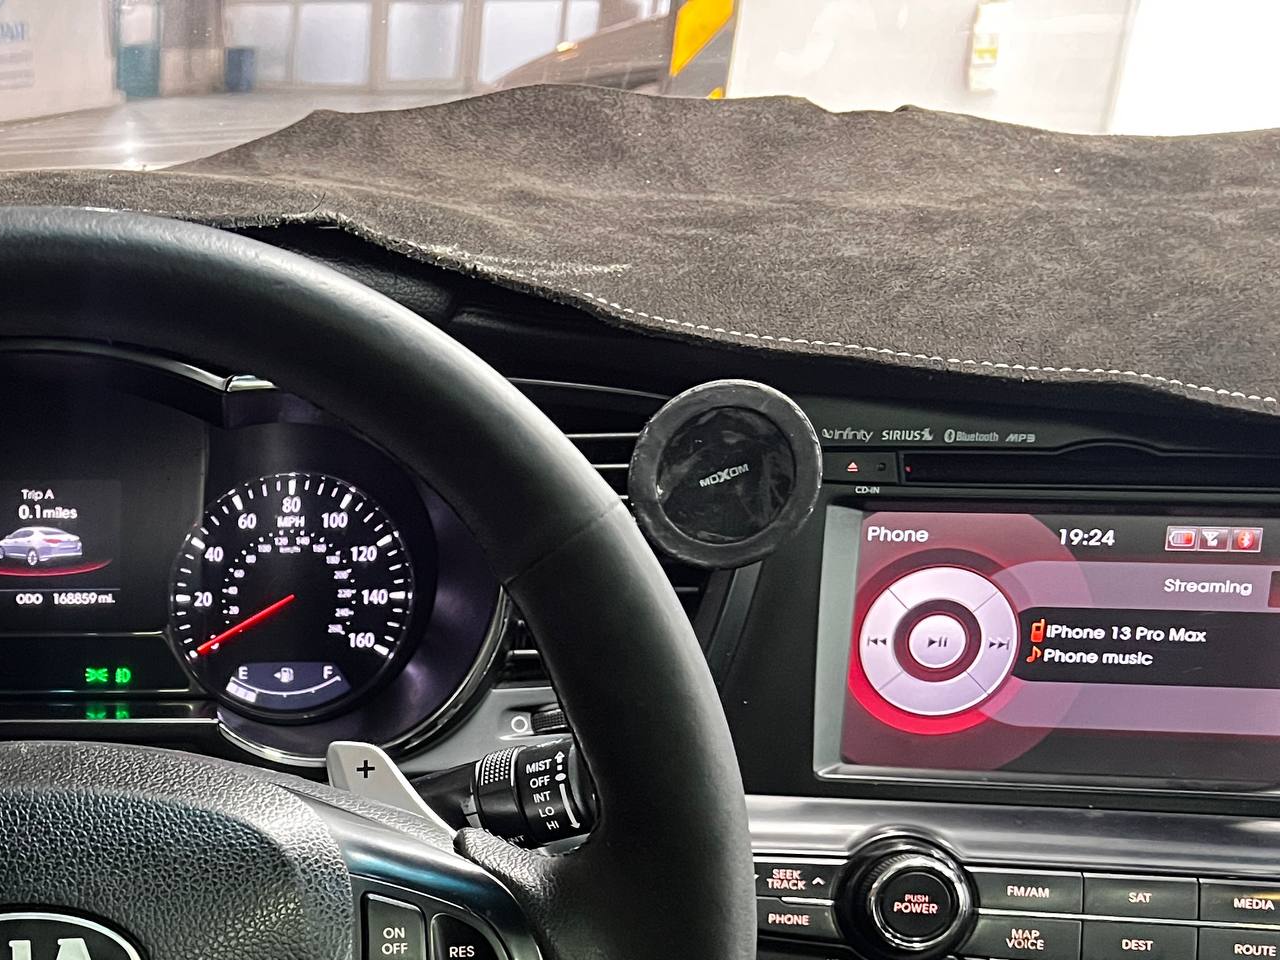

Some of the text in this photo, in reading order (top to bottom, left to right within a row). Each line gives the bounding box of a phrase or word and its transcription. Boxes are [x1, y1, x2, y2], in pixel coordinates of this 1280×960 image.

[956, 431, 999, 442] Bluetooth
[1005, 433, 1036, 443] MP3
[699, 463, 750, 487] MOXOM
[21, 489, 54, 501] Trip A
[855, 486, 880, 495] CD-IN
[282, 497, 301, 512] 80
[18, 505, 78, 519] 0.1 miles
[238, 513, 256, 528] 60
[277, 516, 305, 527] MPH
[322, 513, 348, 528] 100
[867, 526, 928, 543] Phone
[1059, 528, 1115, 546] 19:24
[205, 547, 223, 562] 40
[351, 547, 377, 562] 120
[1164, 578, 1253, 596] Streaming
[16, 593, 43, 604] ODO
[53, 592, 97, 604] 168859
[194, 592, 212, 606] 20
[362, 589, 388, 604] 140
[1046, 624, 1206, 643] iPhone 13 Pro Max
[348, 633, 375, 648] 160
[1043, 649, 1153, 666] Phone music
[238, 667, 248, 679] E
[323, 666, 332, 679] F
[525, 758, 552, 774] MIST
[529, 777, 551, 789] OFF
[533, 791, 551, 804] INT
[538, 806, 555, 818] LO
[546, 820, 559, 831] HI
[773, 869, 801, 880] SEEK
[767, 878, 806, 890] TRACK
[1007, 886, 1050, 898] FM/AM
[1128, 892, 1152, 903] SAT
[905, 894, 928, 903] PUSH
[1234, 898, 1275, 911] MEDIA
[893, 902, 939, 914] POWER
[768, 914, 810, 926] PHONE
[383, 927, 405, 939] ON
[1011, 929, 1040, 939] MAP
[381, 942, 408, 955] OFF
[1006, 938, 1044, 950] VOICE
[1122, 940, 1154, 951] DEST
[449, 946, 475, 958] RES
[1234, 944, 1277, 957] ROUTE
